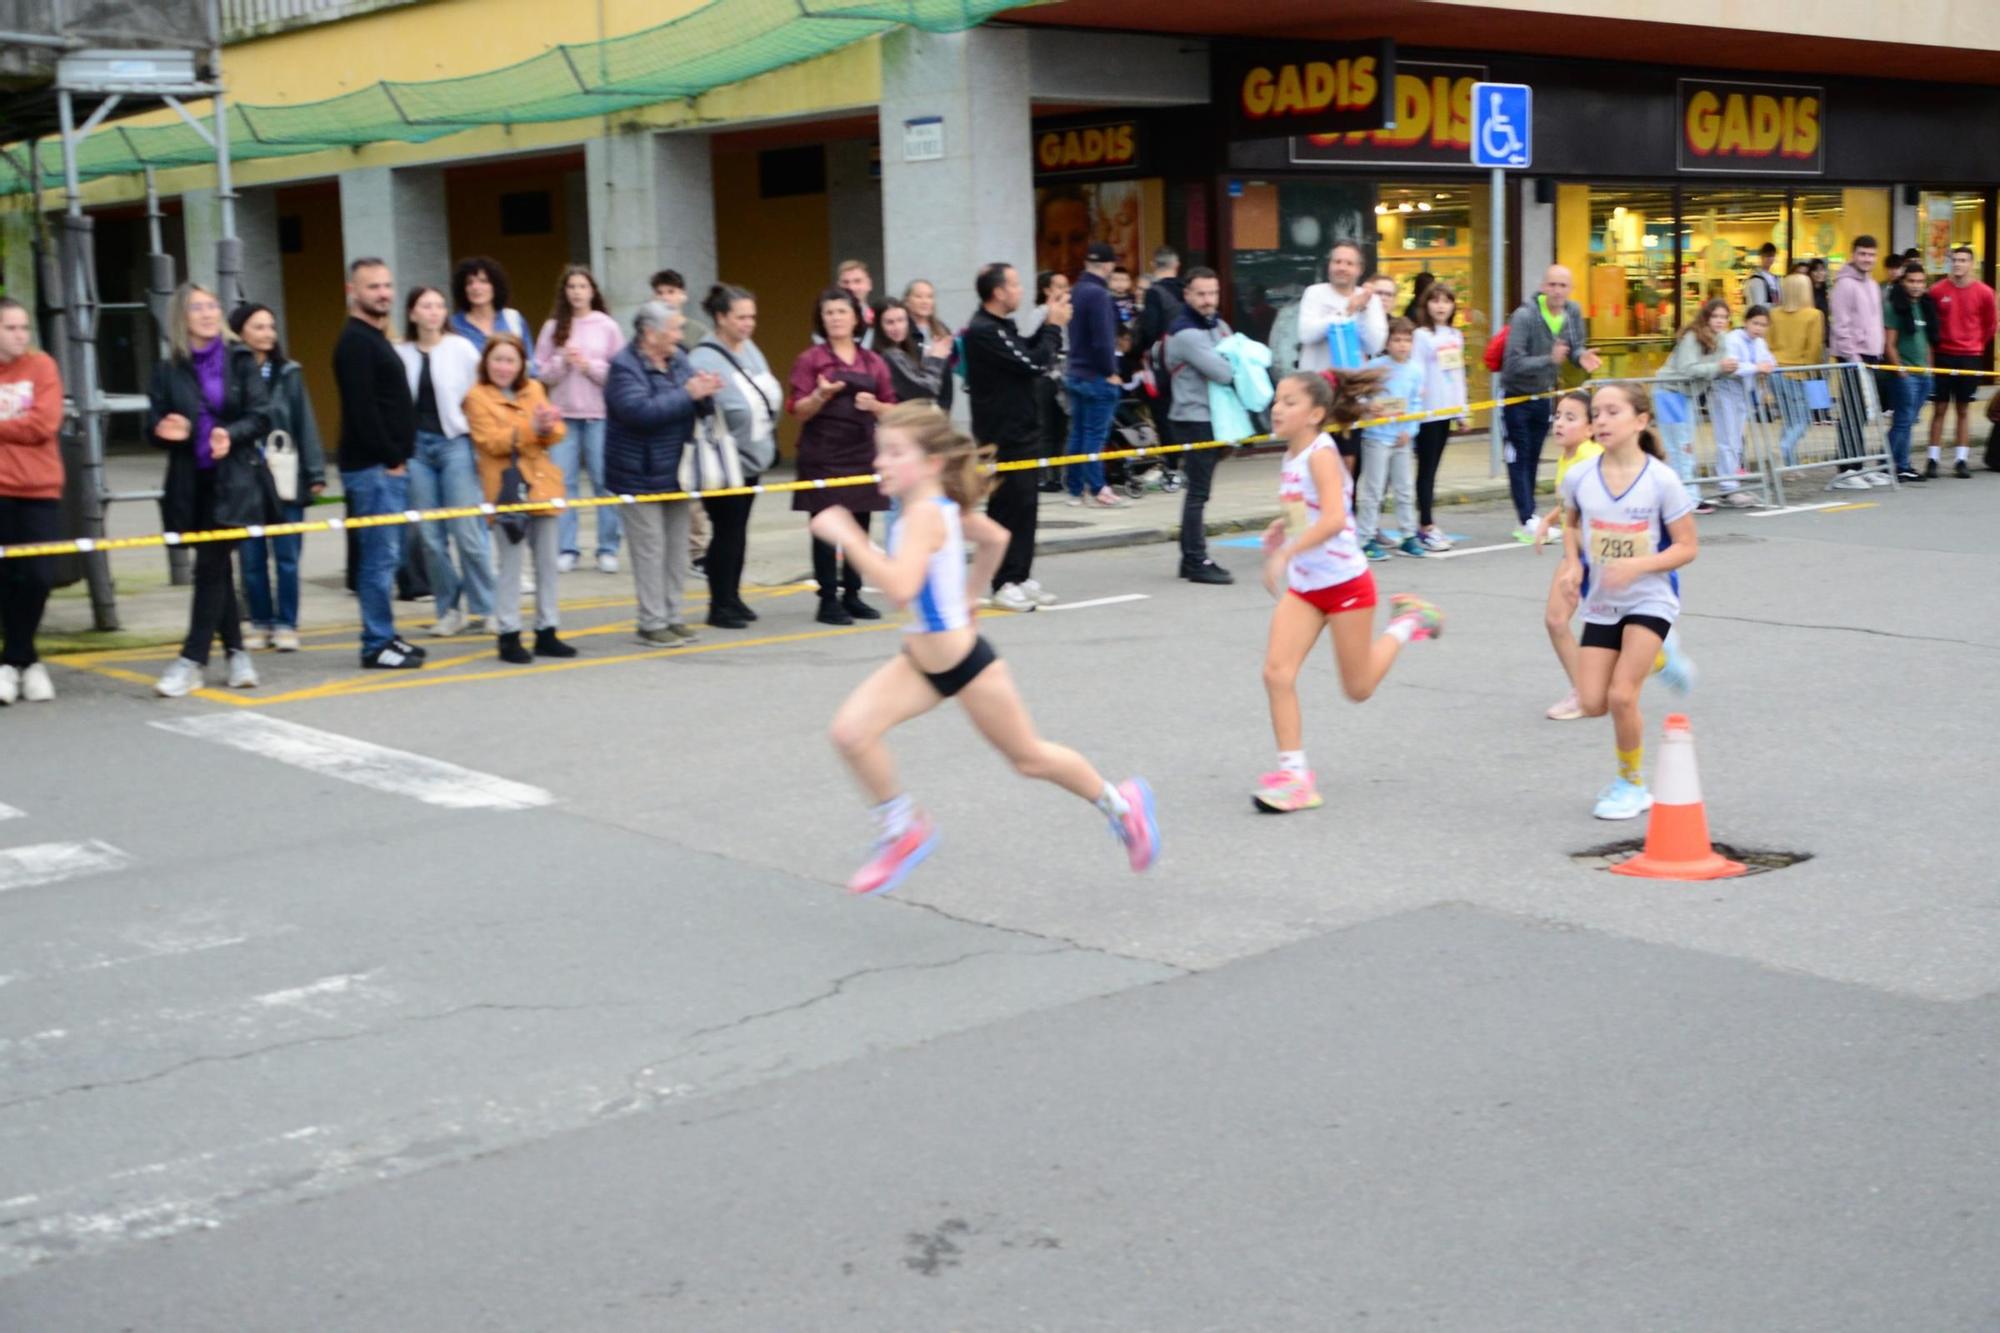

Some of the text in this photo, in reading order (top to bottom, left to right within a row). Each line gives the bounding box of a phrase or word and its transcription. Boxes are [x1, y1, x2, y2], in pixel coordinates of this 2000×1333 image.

[1242, 55, 1378, 117] GADIS
[1308, 74, 1476, 148] DIS
[1040, 125, 1135, 169] GADIS
[1684, 90, 1820, 159] GADIS
[1601, 538, 1633, 558] 293
